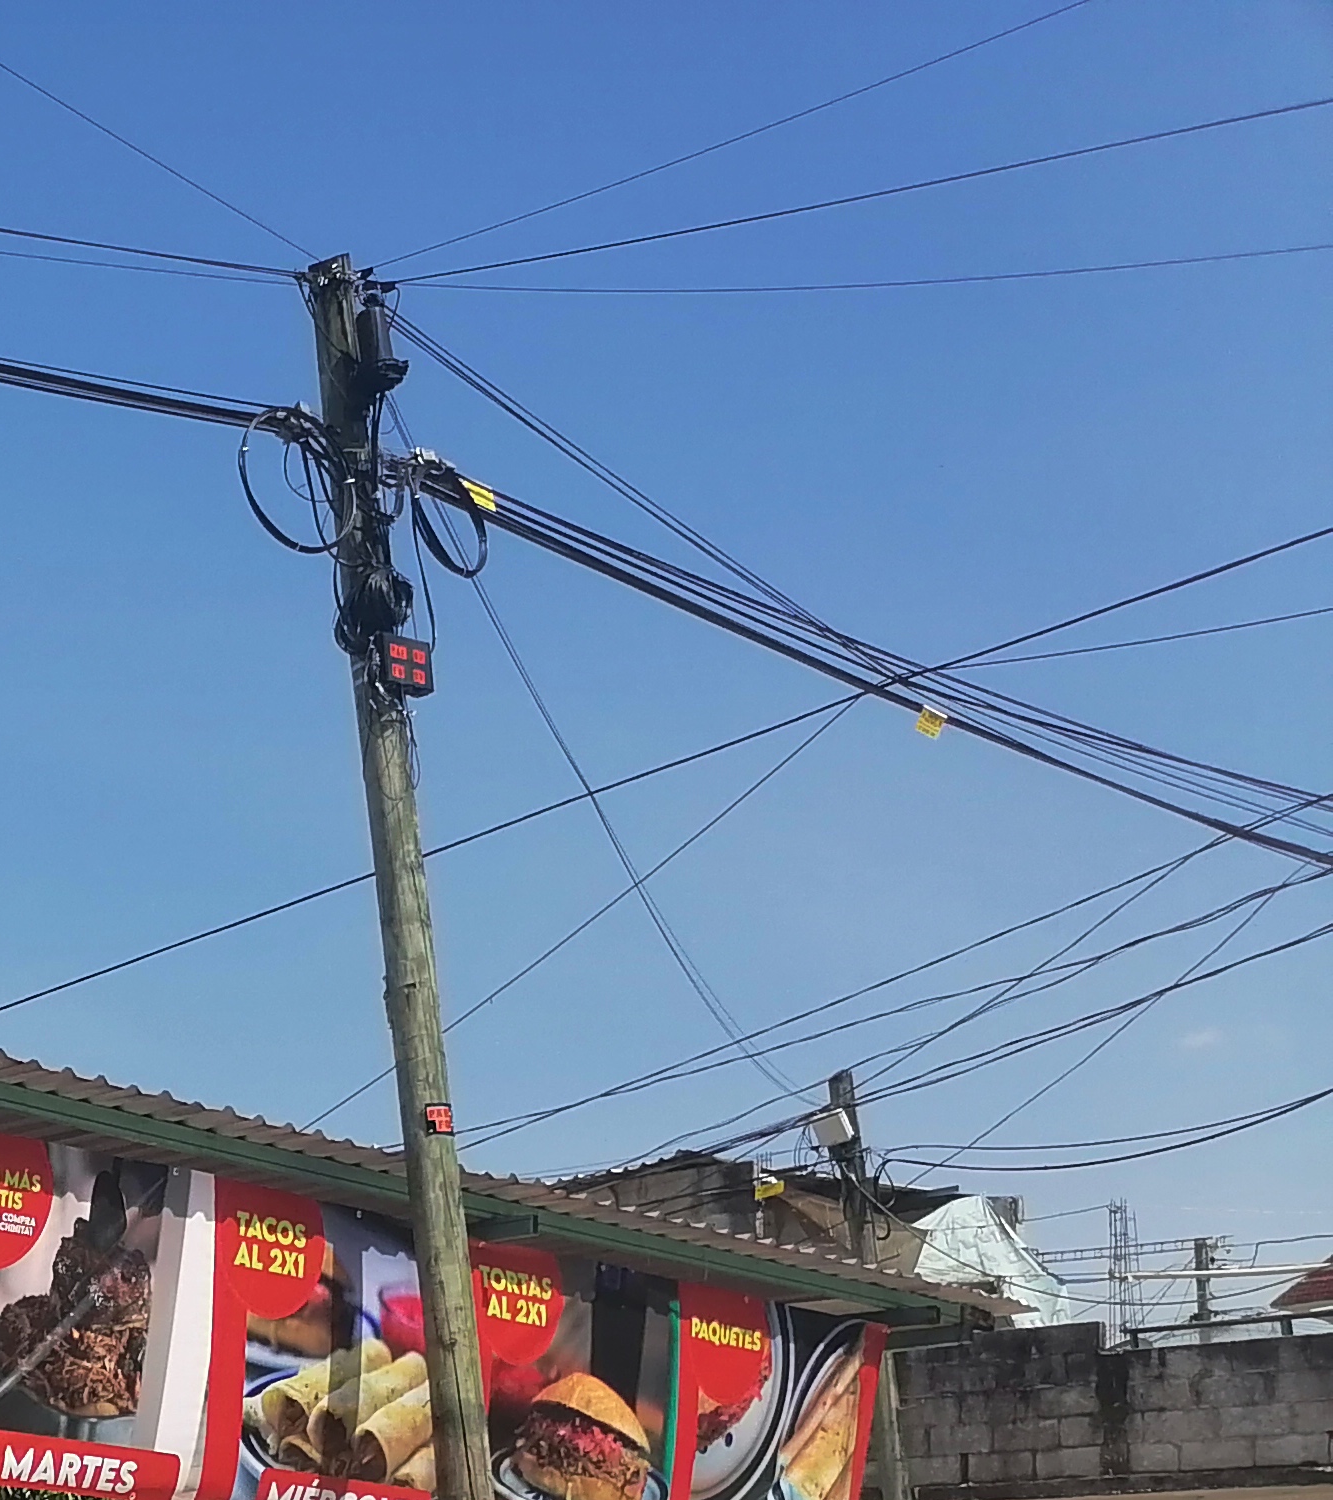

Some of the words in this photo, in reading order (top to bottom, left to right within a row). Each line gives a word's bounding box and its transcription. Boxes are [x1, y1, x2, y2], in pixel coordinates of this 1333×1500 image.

[4, 1168, 41, 1192] MÁS
[2, 1212, 36, 1227] COMPRA
[237, 1211, 307, 1248] TACOS
[235, 1243, 264, 1271] AL
[270, 1249, 306, 1279] 2X1
[481, 1265, 552, 1301] TORTAS
[487, 1294, 512, 1321] AL
[516, 1300, 547, 1327] 2X1
[691, 1317, 762, 1351] PAQUETES
[0, 1446, 138, 1494] MARTES
